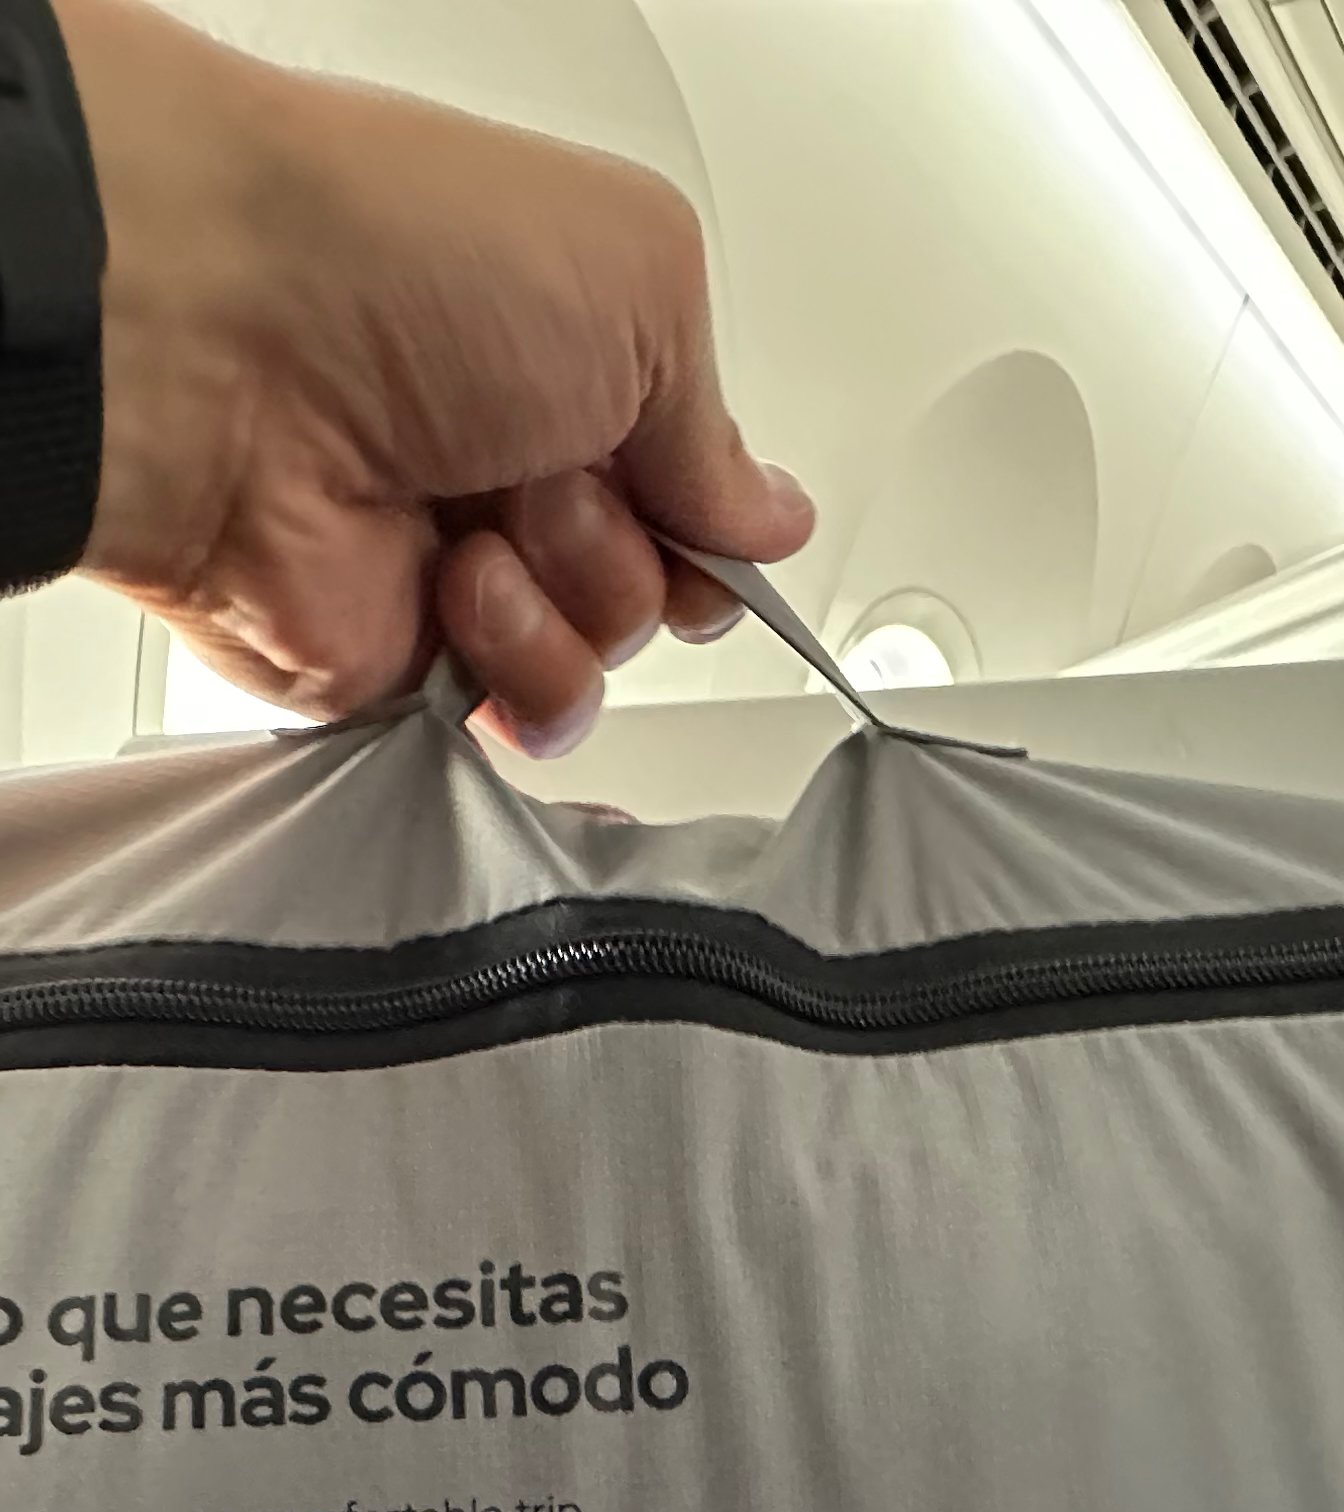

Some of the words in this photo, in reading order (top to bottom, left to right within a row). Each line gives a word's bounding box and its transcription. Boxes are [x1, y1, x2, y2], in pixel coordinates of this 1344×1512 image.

[47, 1281, 202, 1362] que
[225, 1259, 630, 1340] necesitas
[161, 1354, 331, 1432] más
[346, 1346, 690, 1424] cómodo
